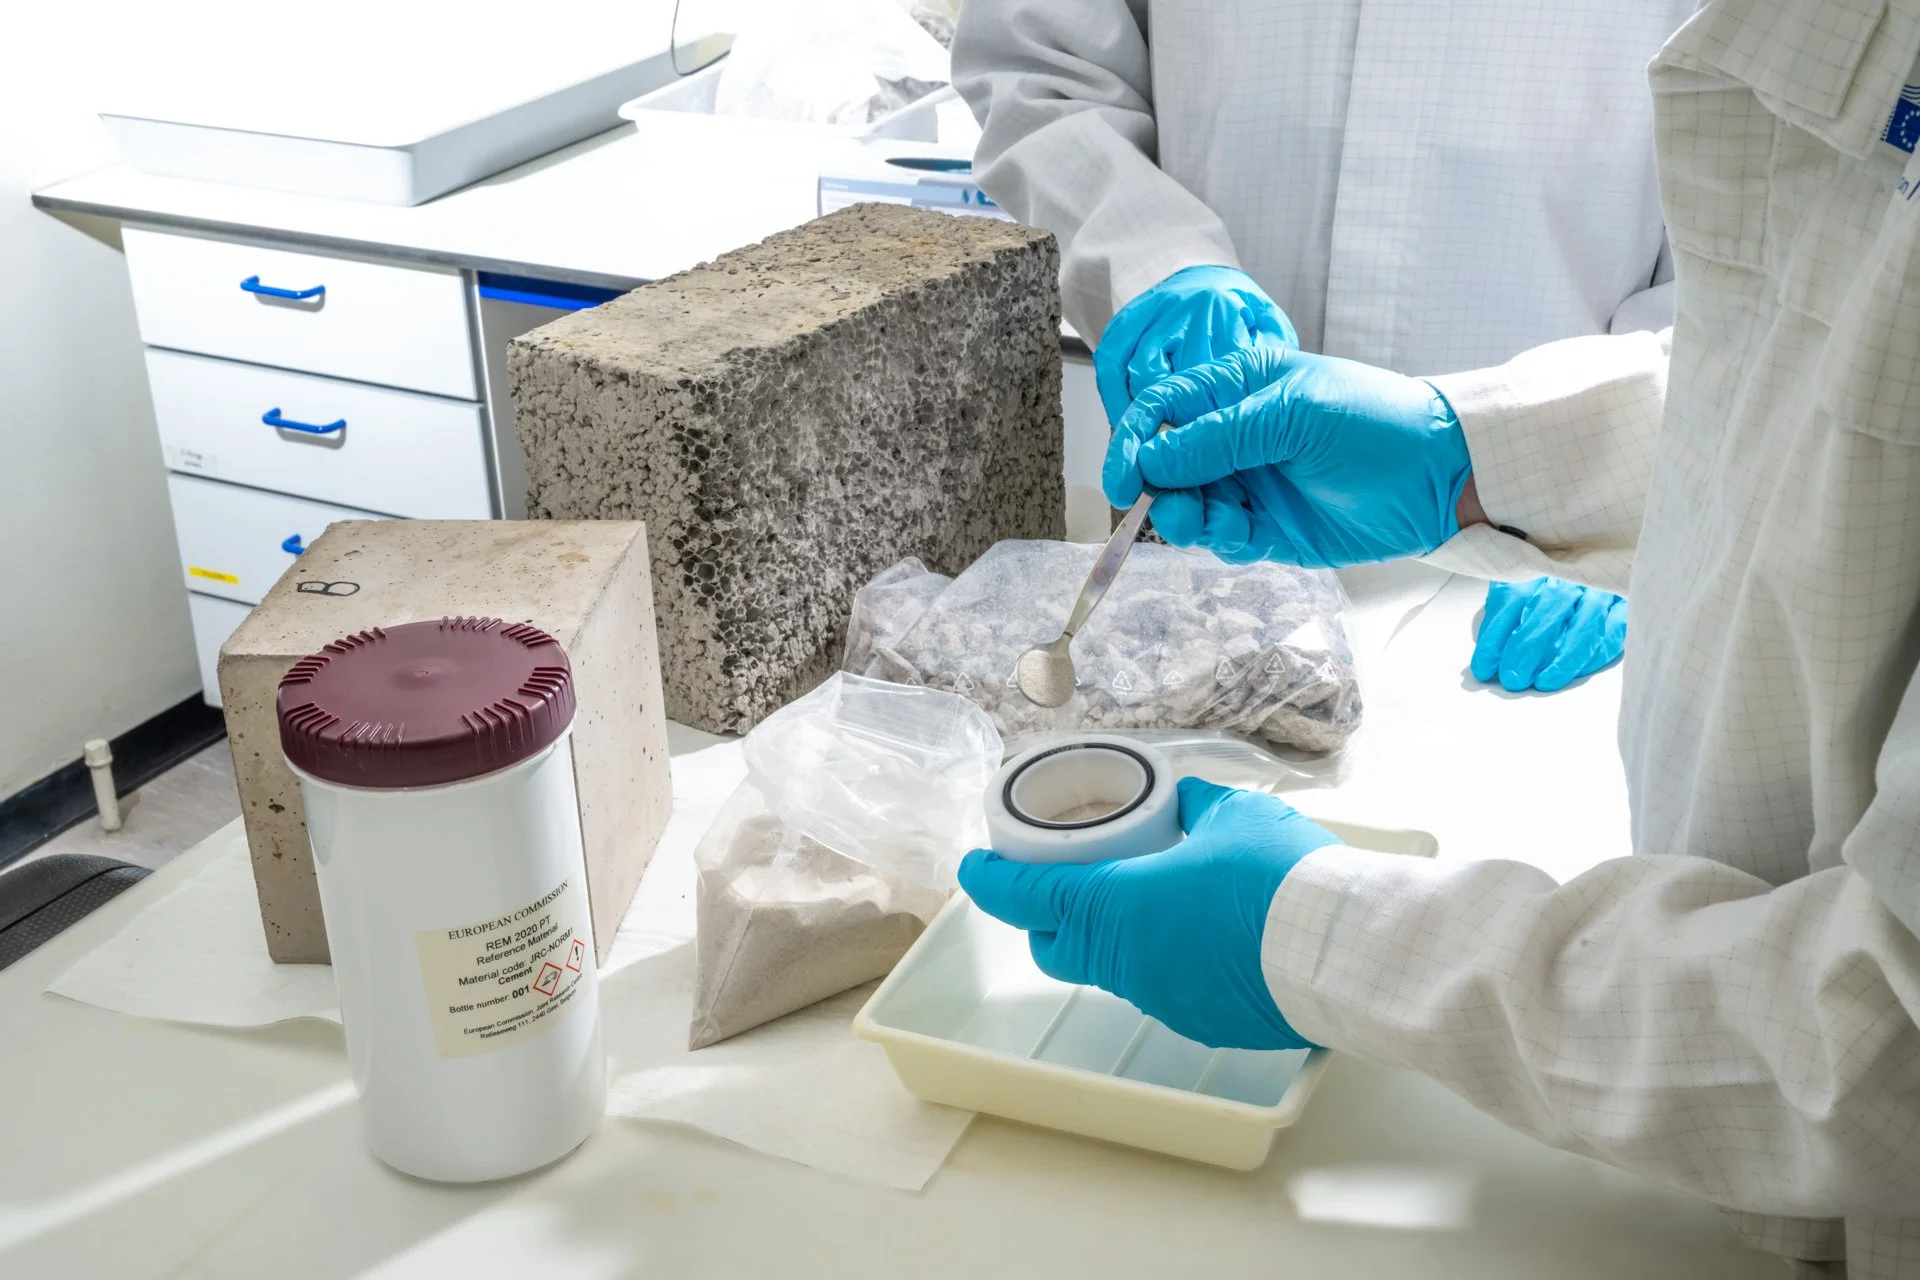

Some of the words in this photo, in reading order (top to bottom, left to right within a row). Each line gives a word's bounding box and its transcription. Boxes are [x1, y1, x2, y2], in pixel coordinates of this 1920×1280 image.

[296, 580, 360, 597] B
[448, 915, 512, 940] EUROPEAN
[514, 879, 568, 921] COMMISSION
[476, 943, 526, 965] Reference
[527, 922, 559, 948] Material
[486, 936, 512, 952] REM
[515, 924, 538, 942] 2020
[540, 915, 551, 930] PT
[458, 970, 500, 987] Material
[502, 960, 527, 975] code:
[498, 966, 533, 986] Cement
[449, 1004, 474, 1014] Bottle
[476, 995, 510, 1010] number:
[512, 984, 530, 999] 001
[463, 1023, 495, 1035] European
[536, 1000, 549, 1011] Joint
[549, 985, 571, 1003] Research
[480, 1024, 517, 1040] Retieseweg
[532, 1011, 546, 1022] 2440
[560, 989, 577, 1005] Belgium
